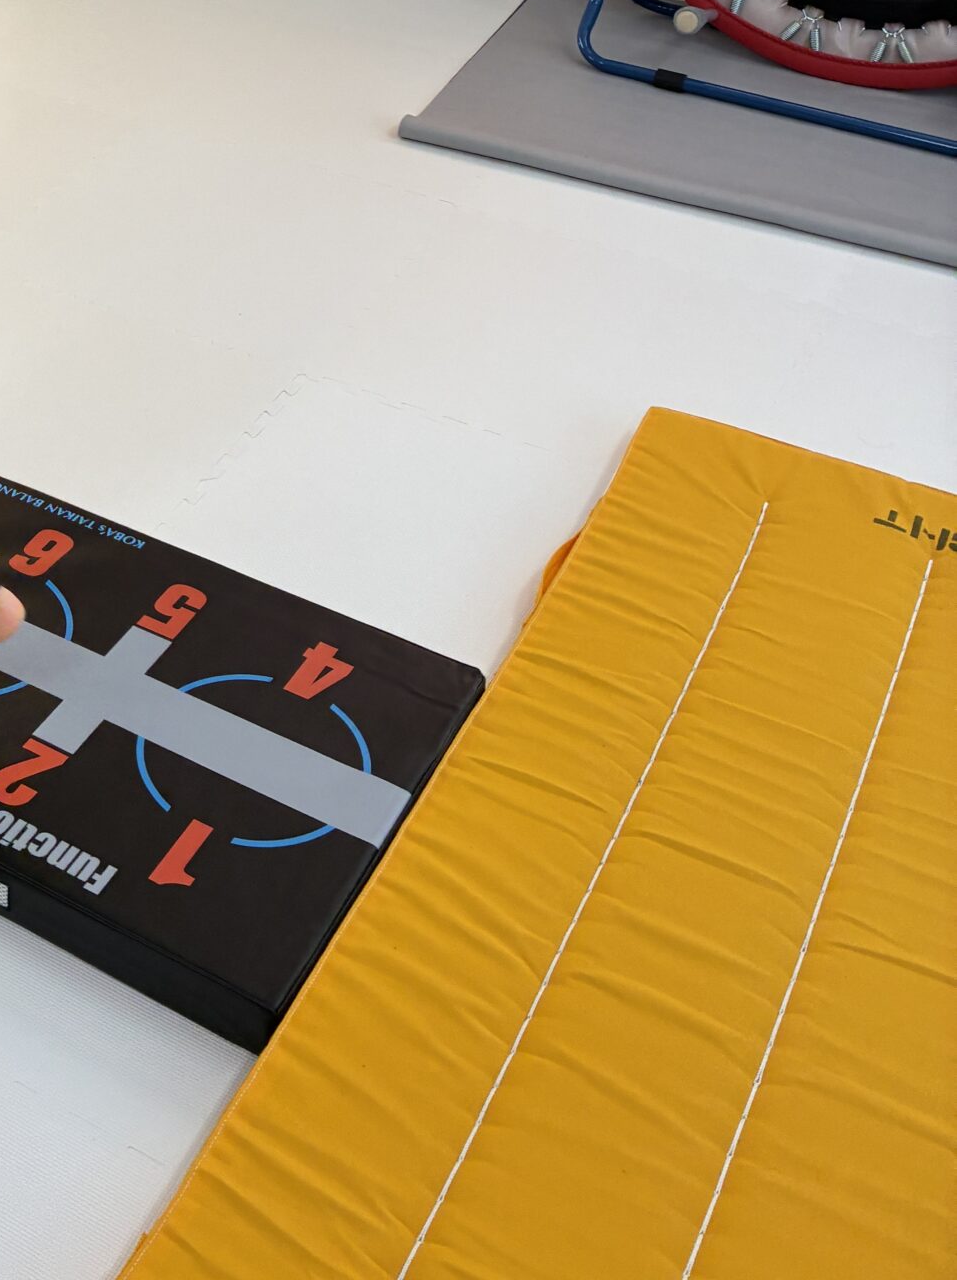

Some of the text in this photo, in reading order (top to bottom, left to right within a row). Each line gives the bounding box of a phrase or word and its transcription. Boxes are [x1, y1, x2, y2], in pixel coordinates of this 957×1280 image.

[44, 503, 95, 529] TAIKAN
[8, 529, 74, 577] 6
[136, 584, 208, 640] 5
[283, 642, 354, 700] 4
[148, 819, 214, 887] 1
